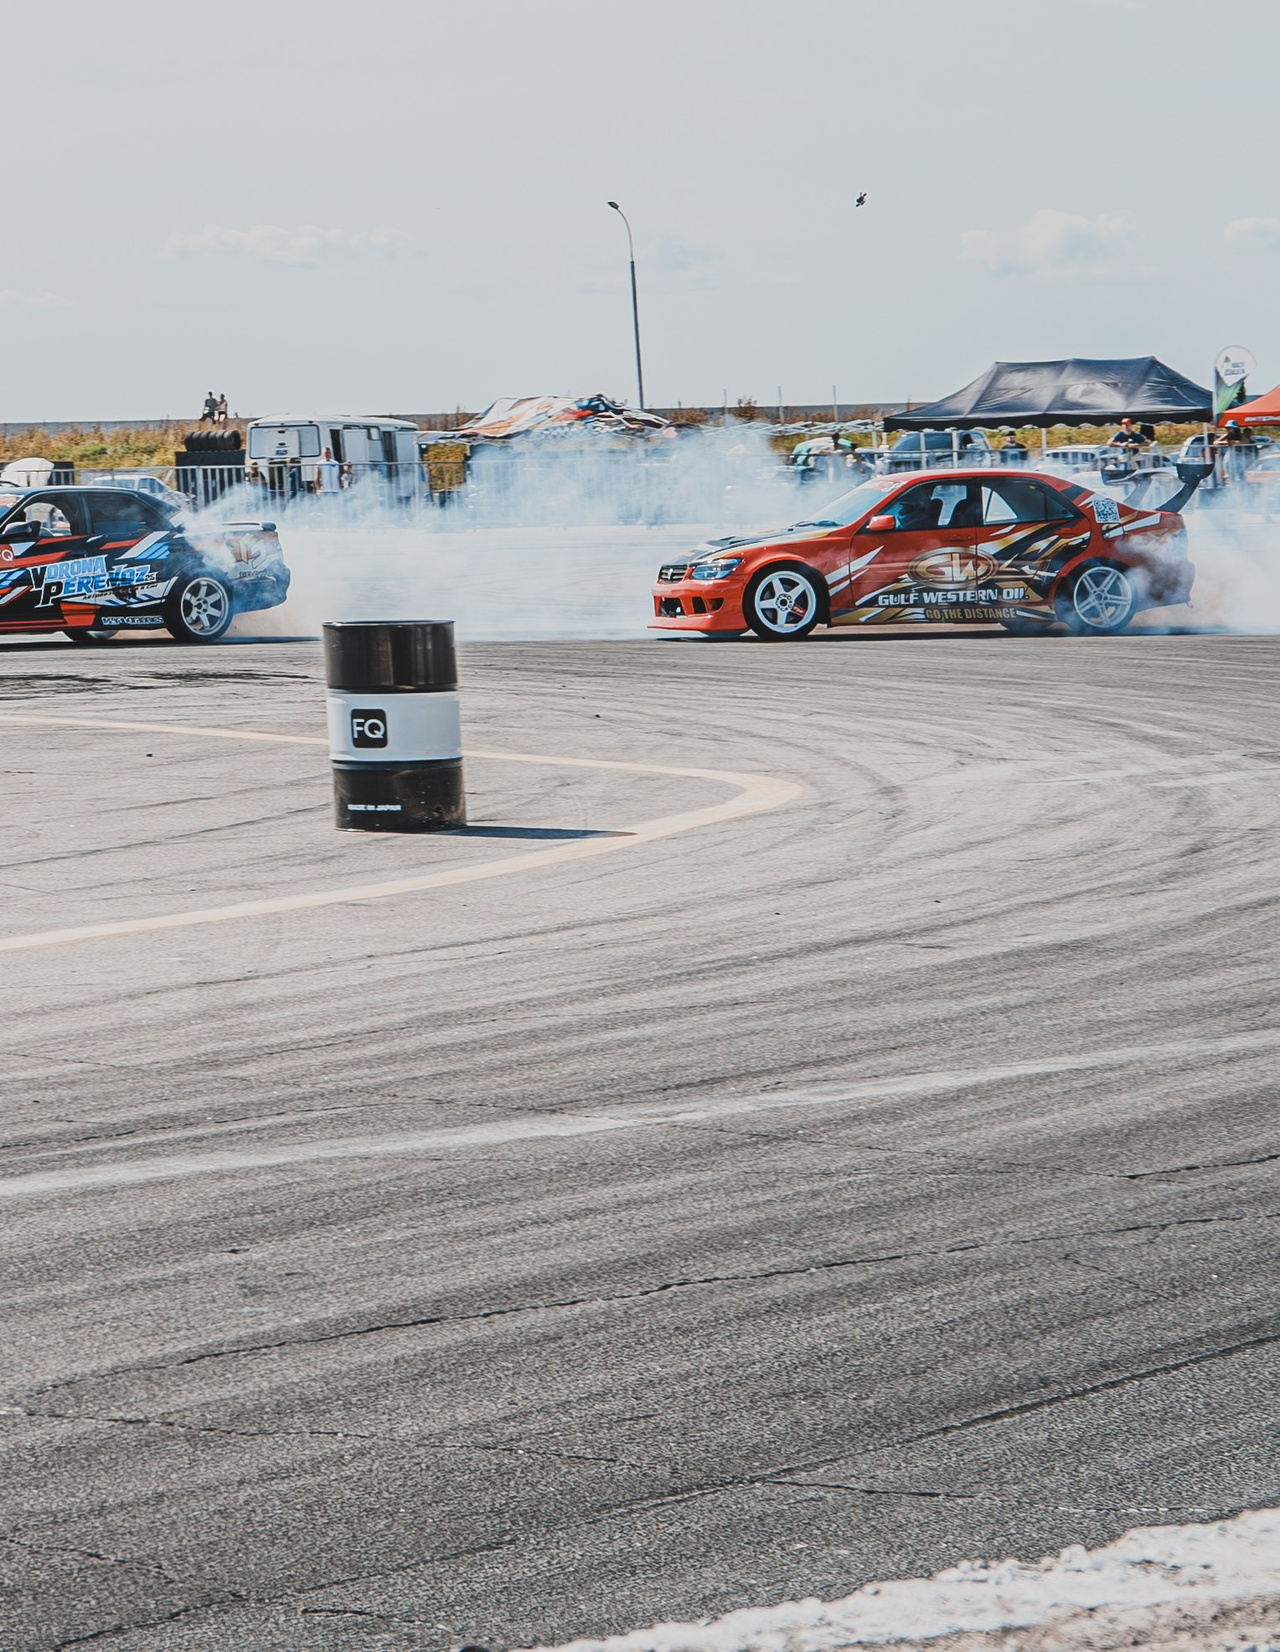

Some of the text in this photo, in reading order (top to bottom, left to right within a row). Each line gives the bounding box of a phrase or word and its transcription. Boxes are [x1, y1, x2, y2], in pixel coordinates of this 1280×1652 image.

[26, 554, 108, 592] VORONA
[878, 593, 919, 606] GULF
[922, 588, 998, 603] WESTERN
[925, 607, 1017, 619] GO THE DISTANCE
[353, 718, 385, 739] FQ
